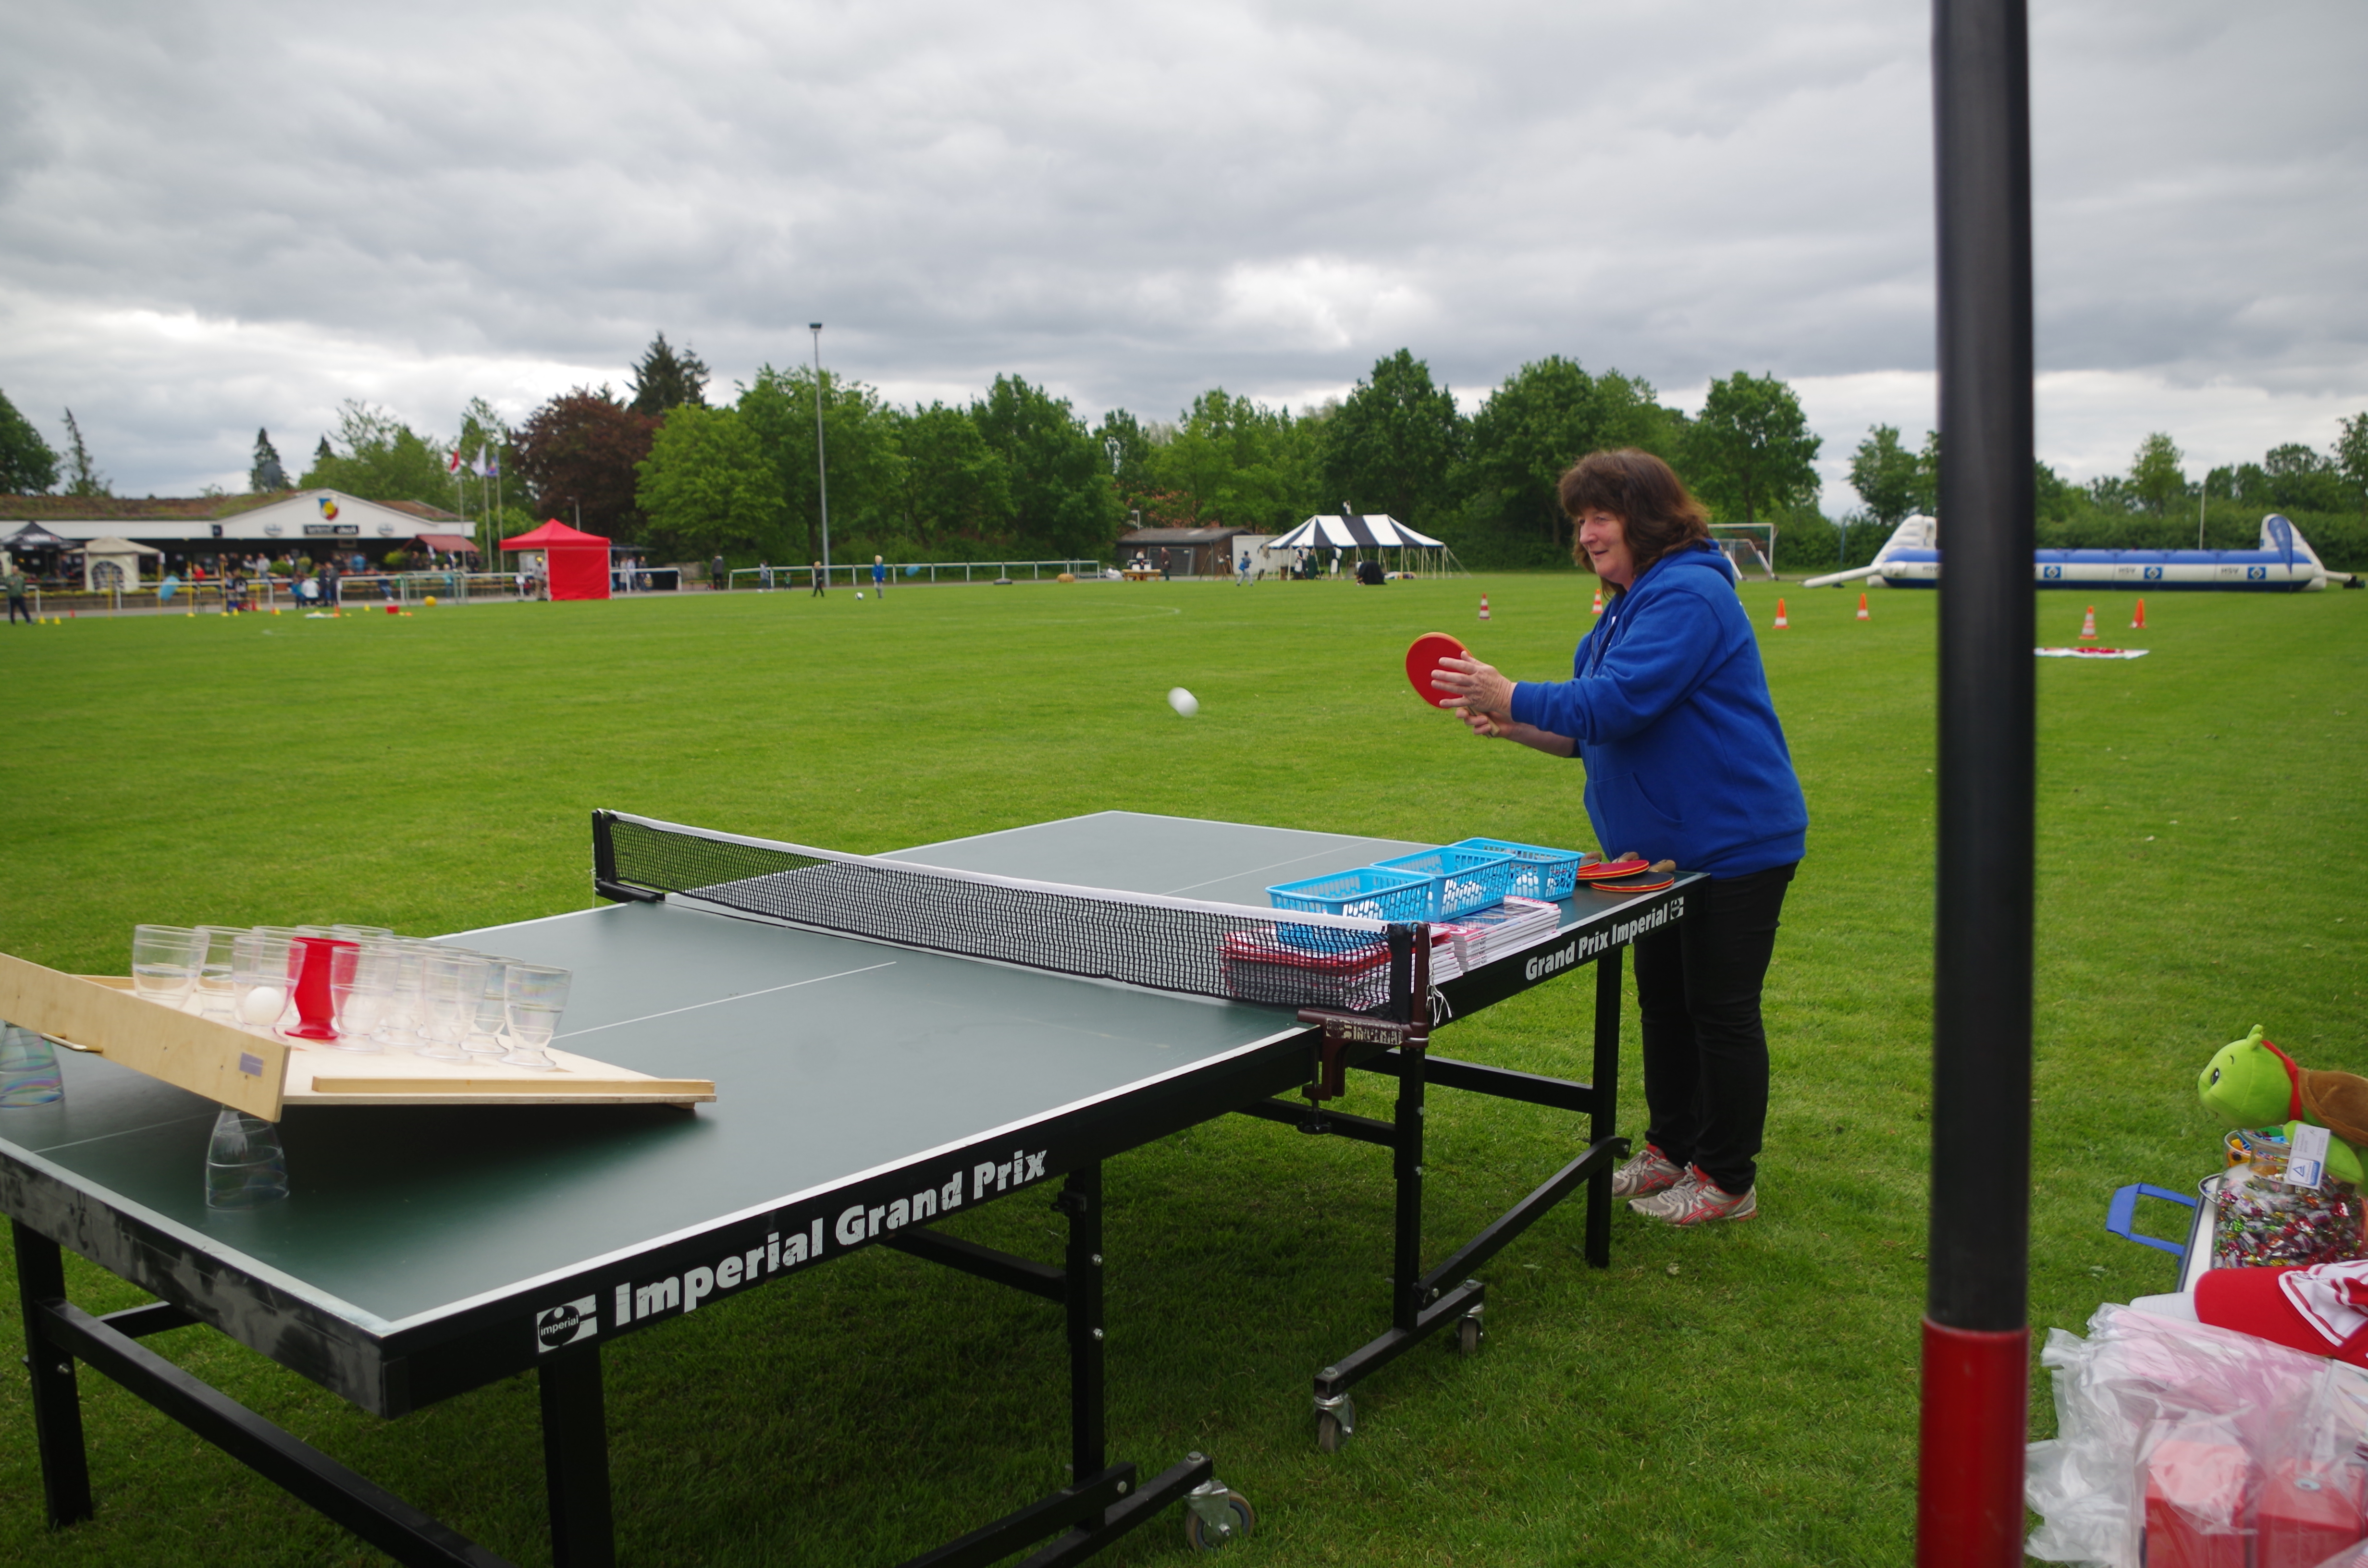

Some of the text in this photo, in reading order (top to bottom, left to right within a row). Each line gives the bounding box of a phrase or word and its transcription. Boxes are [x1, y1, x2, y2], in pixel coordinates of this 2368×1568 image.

[1526, 903, 1668, 980] Grand Prix Imperial
[615, 1150, 1047, 1327] Imperial Grand Prix
[541, 1314, 579, 1336] imperial
